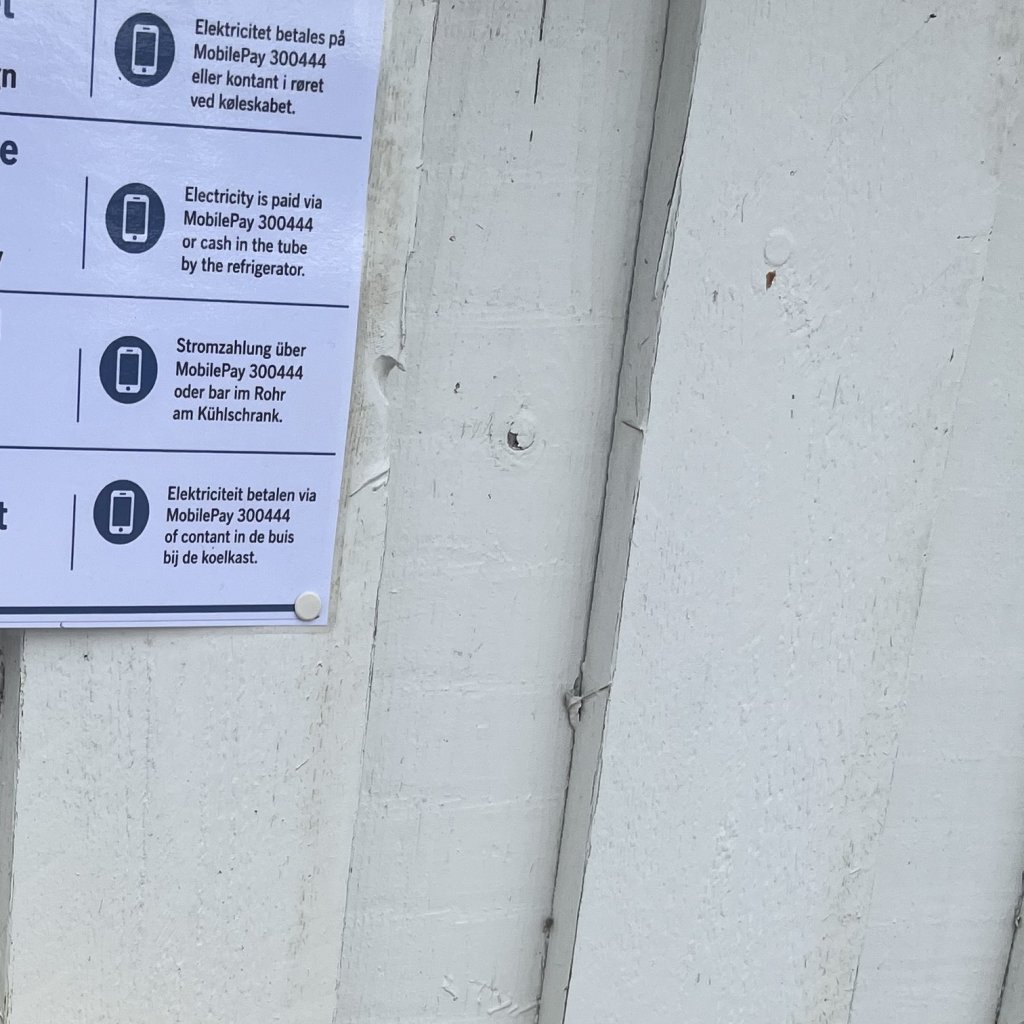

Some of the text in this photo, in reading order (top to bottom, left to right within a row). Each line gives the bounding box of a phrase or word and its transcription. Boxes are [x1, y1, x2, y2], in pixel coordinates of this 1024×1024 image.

[196, 19, 345, 48] Elektricitet betales på
[194, 44, 326, 68] MobilePay 300444
[192, 68, 323, 93] eller kontant i røret
[191, 93, 295, 114] ved køleskabet.
[186, 187, 322, 209] Electricity is paid via
[184, 210, 313, 232] MobilePay 300444
[183, 236, 307, 254] or cash in the tube
[182, 256, 304, 278] by the refrigerator.
[177, 338, 306, 359] Stromzahlung über
[176, 361, 303, 381] MobilePay 300444
[175, 384, 286, 401] oder bar im Rohr
[173, 407, 282, 422] am Kühlschrank.
[168, 486, 316, 501] Elektriciteit betalen via
[167, 508, 290, 525] MobilePay 300444
[165, 529, 294, 543] of contant in de buis
[164, 550, 257, 567] bij de koelkast.
